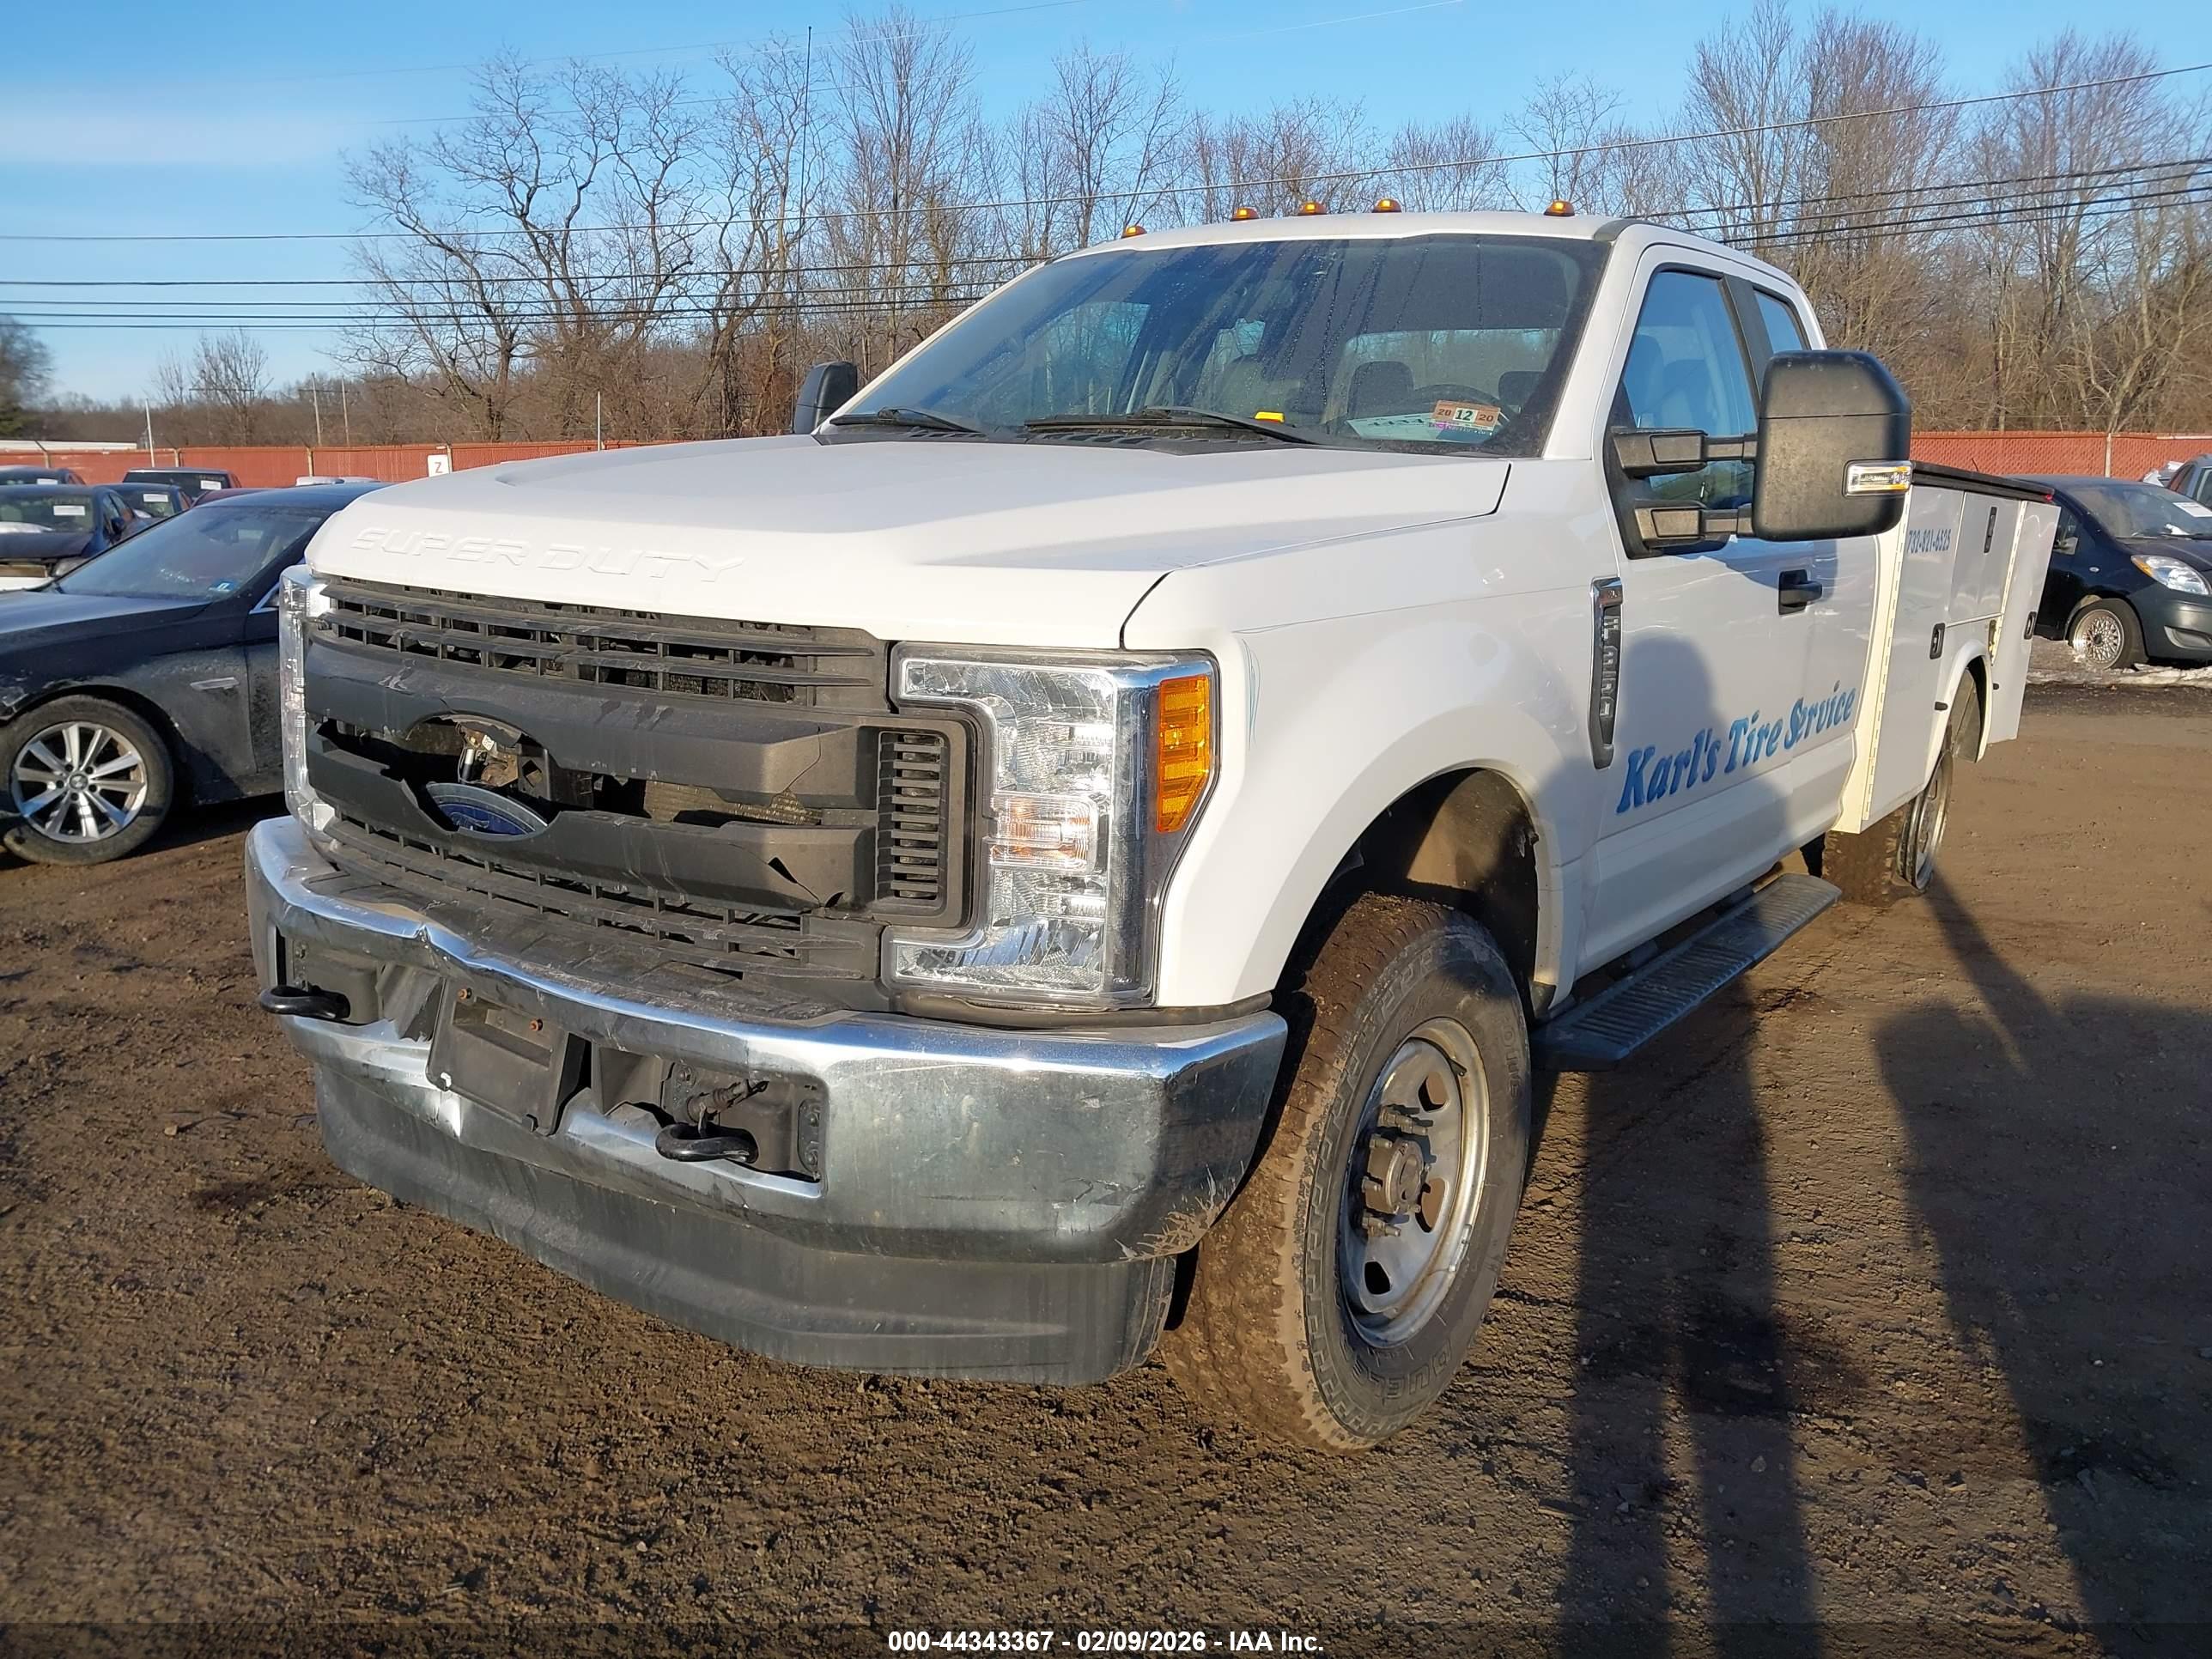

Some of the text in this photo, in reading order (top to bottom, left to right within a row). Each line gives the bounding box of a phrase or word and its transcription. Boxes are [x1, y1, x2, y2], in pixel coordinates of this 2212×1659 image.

[1455, 409, 1474, 421] 12
[1478, 413, 1494, 422] 20
[351, 526, 744, 582] SUPER DUTY
[1616, 680, 1856, 815] Karl's Tire Service
